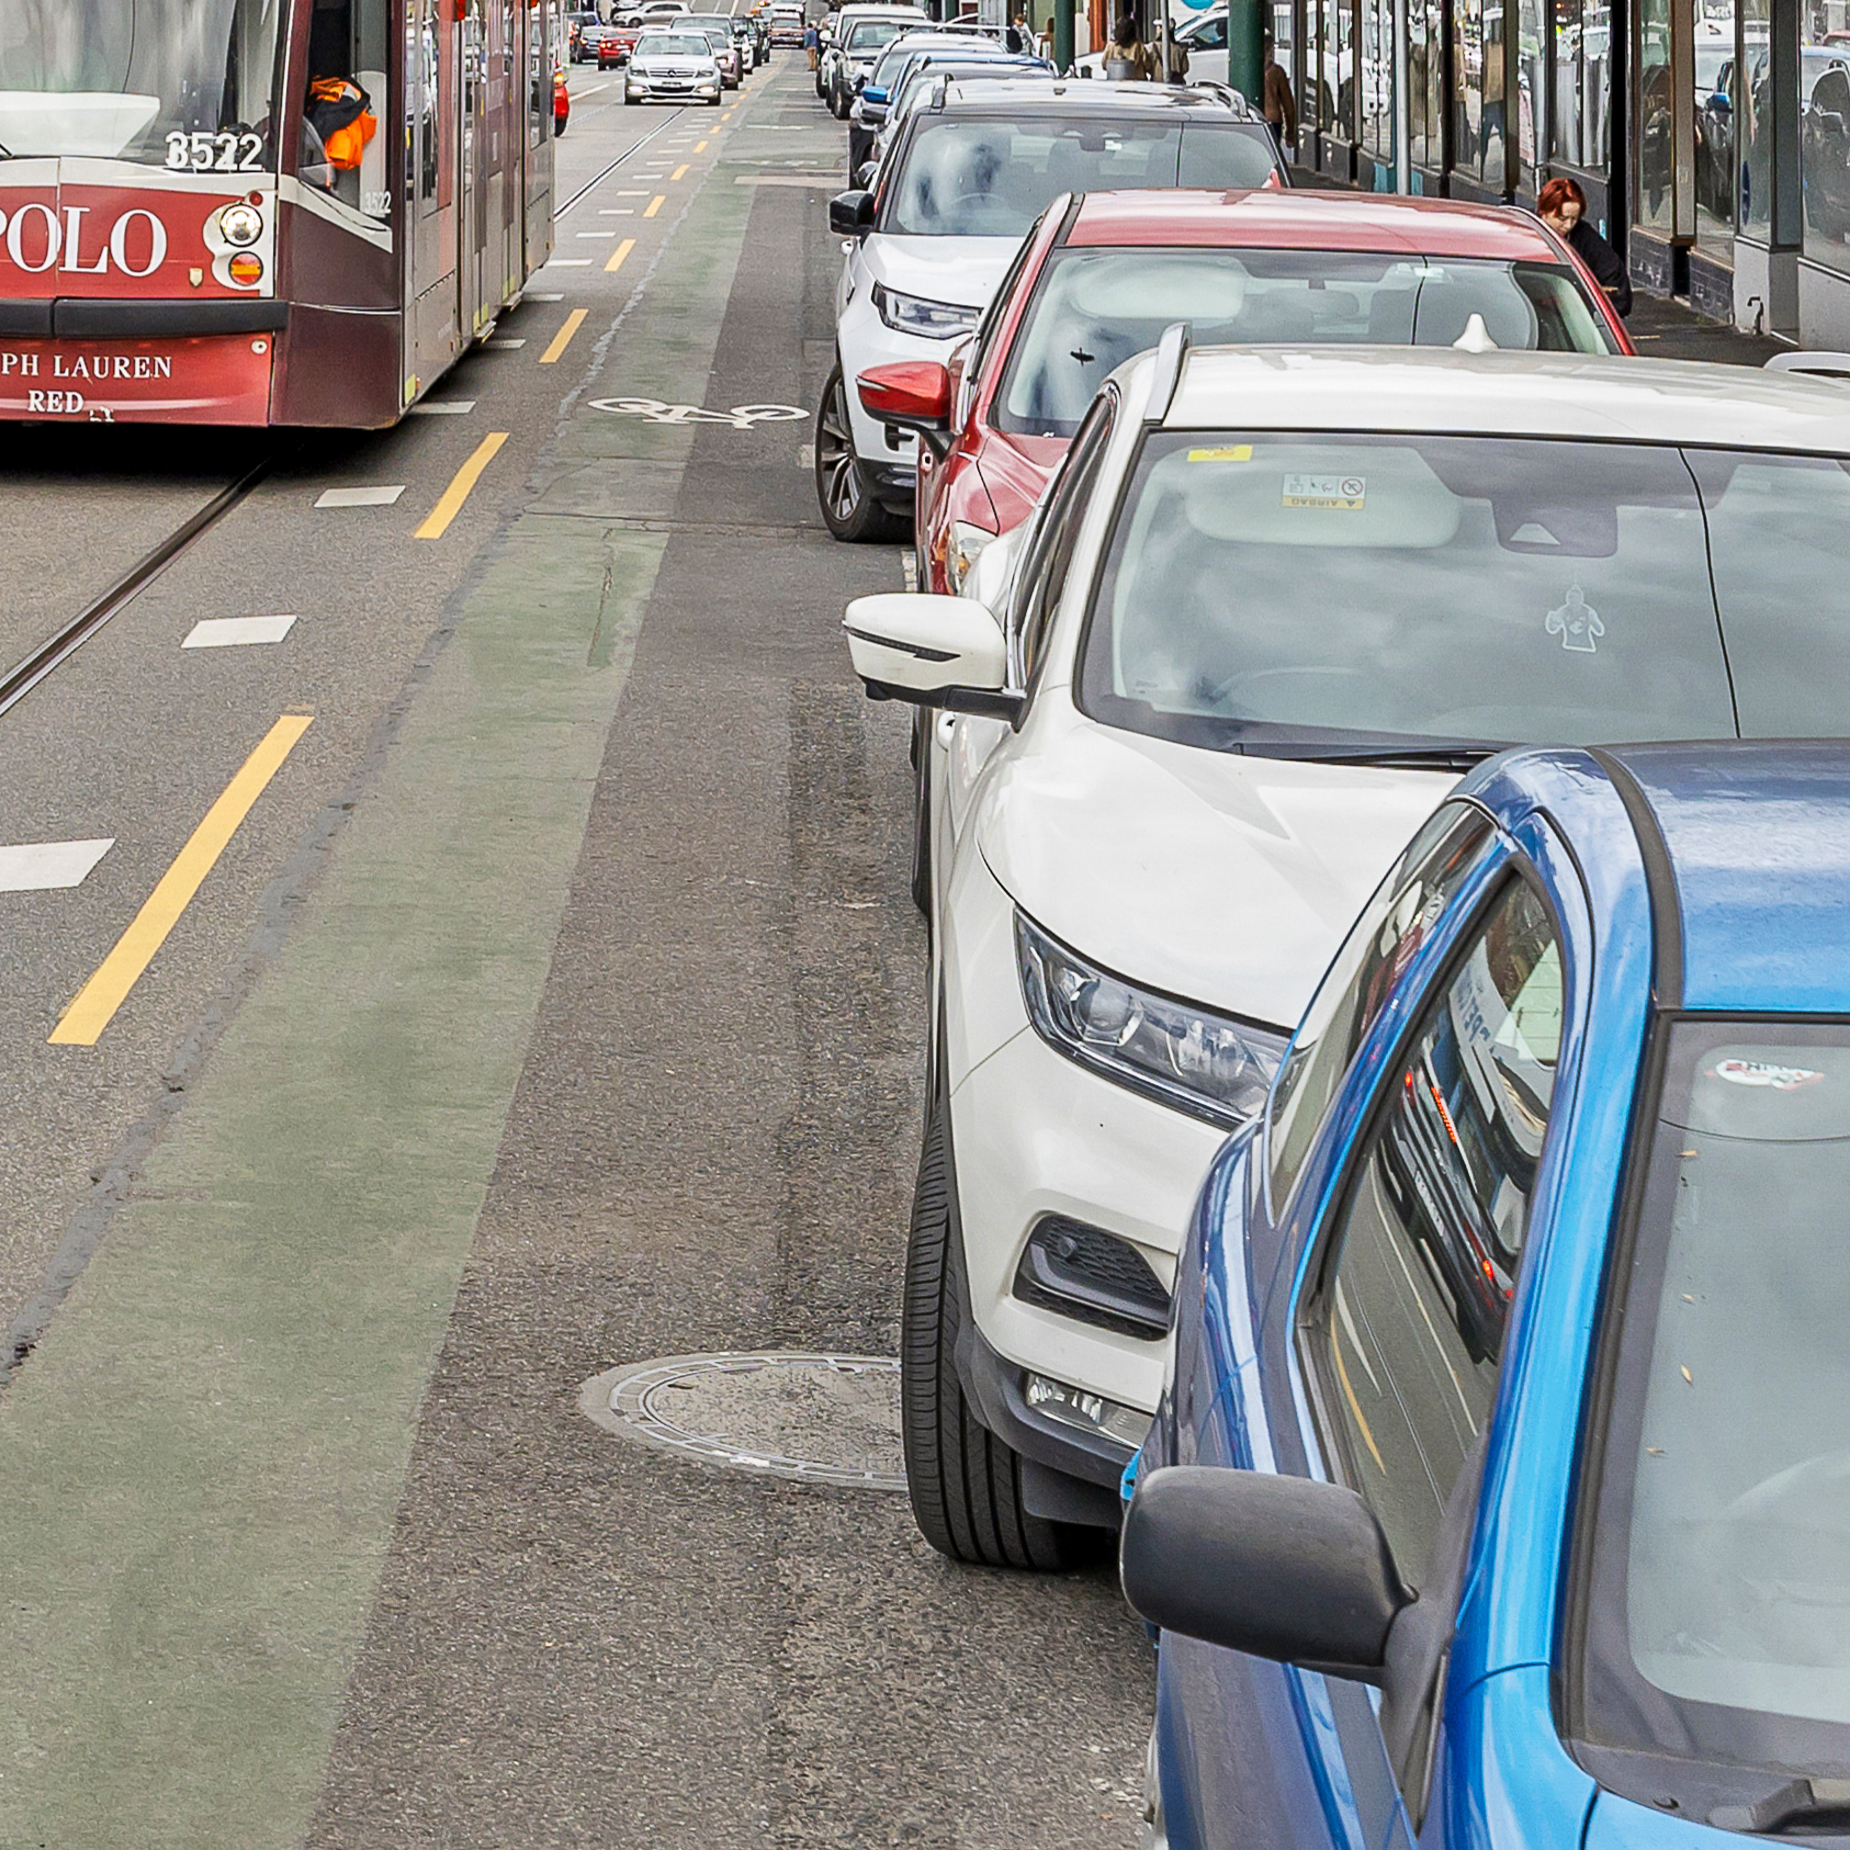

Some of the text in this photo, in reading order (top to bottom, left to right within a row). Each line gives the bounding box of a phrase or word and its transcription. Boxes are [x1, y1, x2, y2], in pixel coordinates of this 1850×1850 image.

[364, 191, 392, 215] 3522
[53, 356, 172, 378] LAUREN
[27, 389, 85, 413] RED
